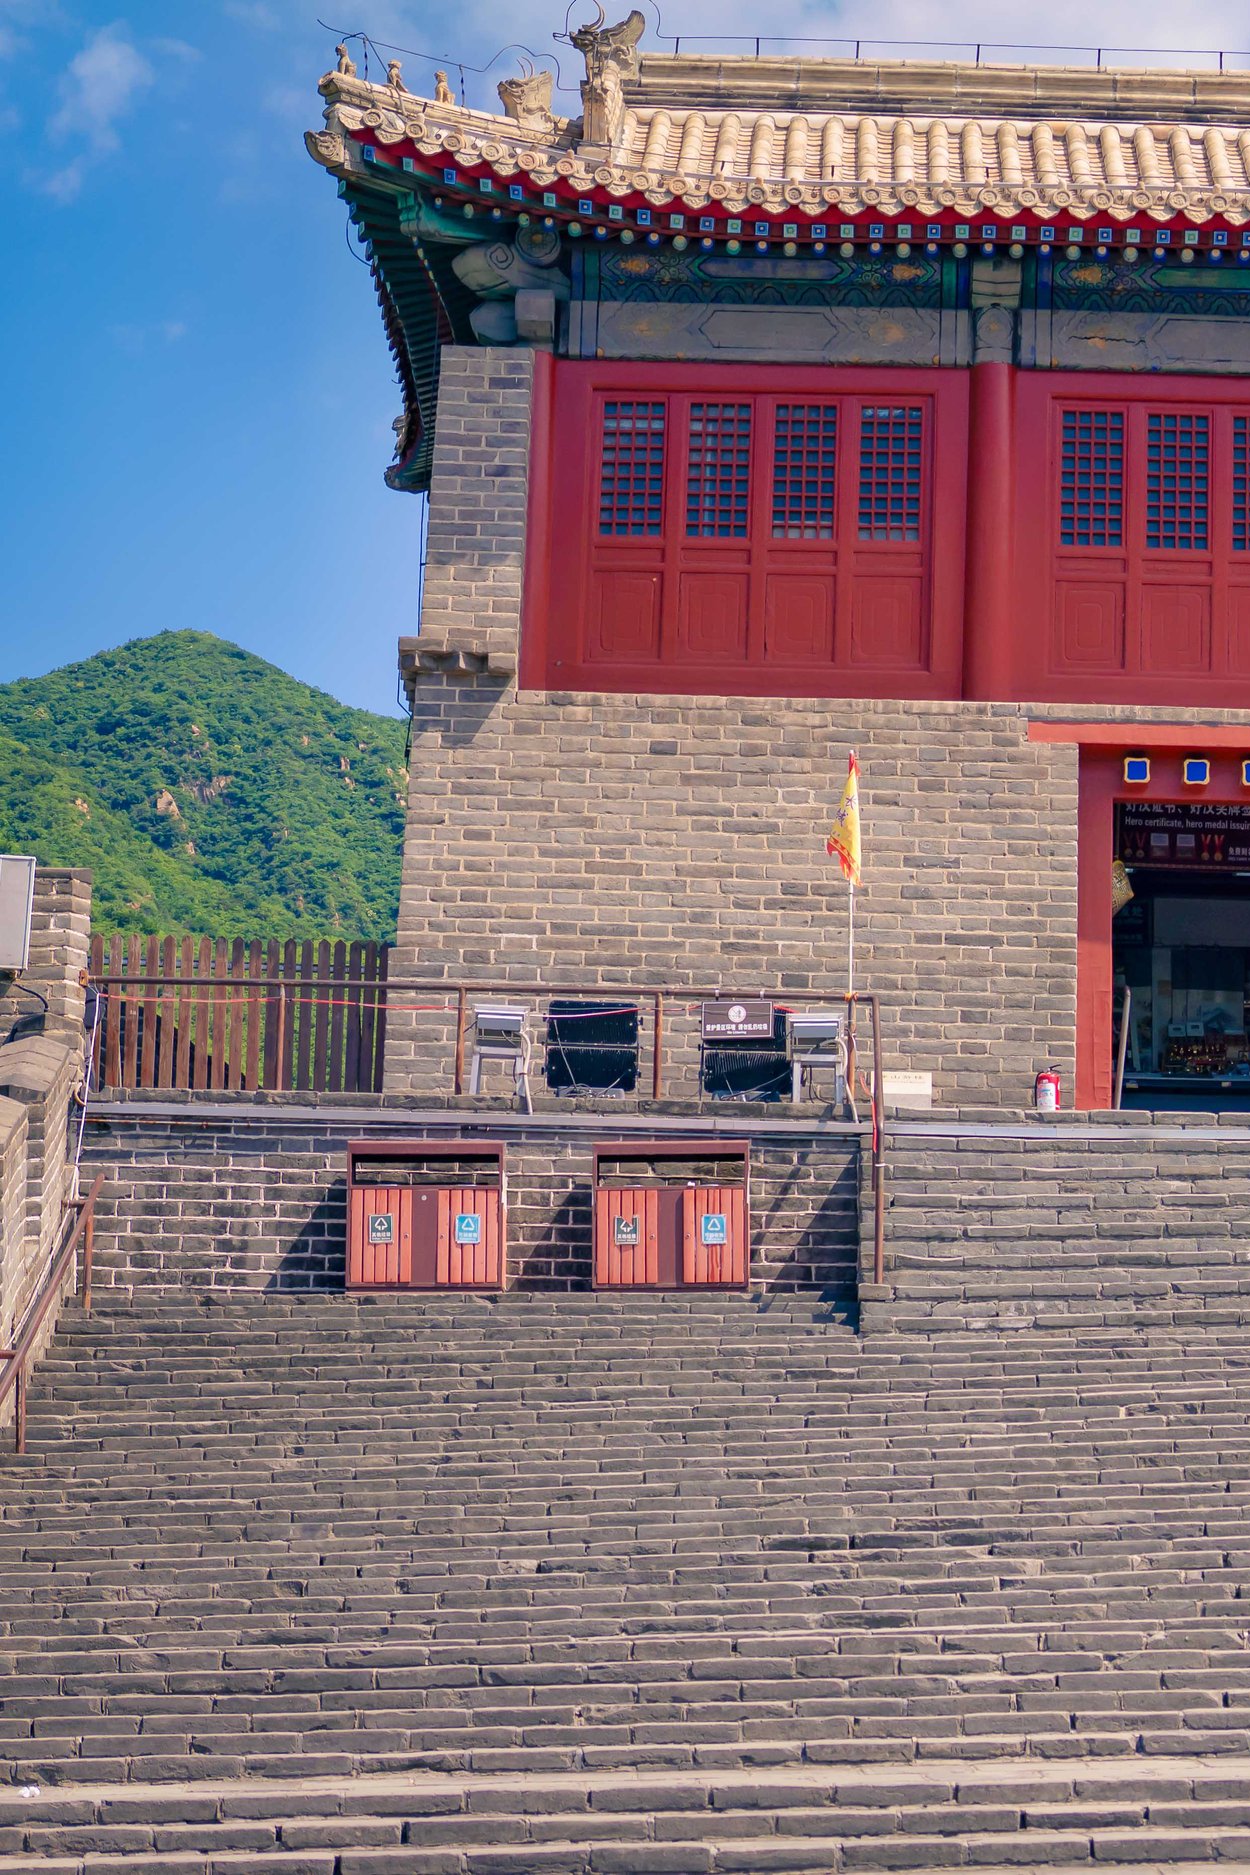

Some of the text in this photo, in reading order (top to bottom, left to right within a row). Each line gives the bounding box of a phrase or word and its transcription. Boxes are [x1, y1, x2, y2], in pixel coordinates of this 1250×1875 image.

[1125, 816, 1143, 826] Hero
[1144, 817, 1184, 829] certificate,
[1186, 818, 1203, 828] hero
[1204, 819, 1228, 829] medal
